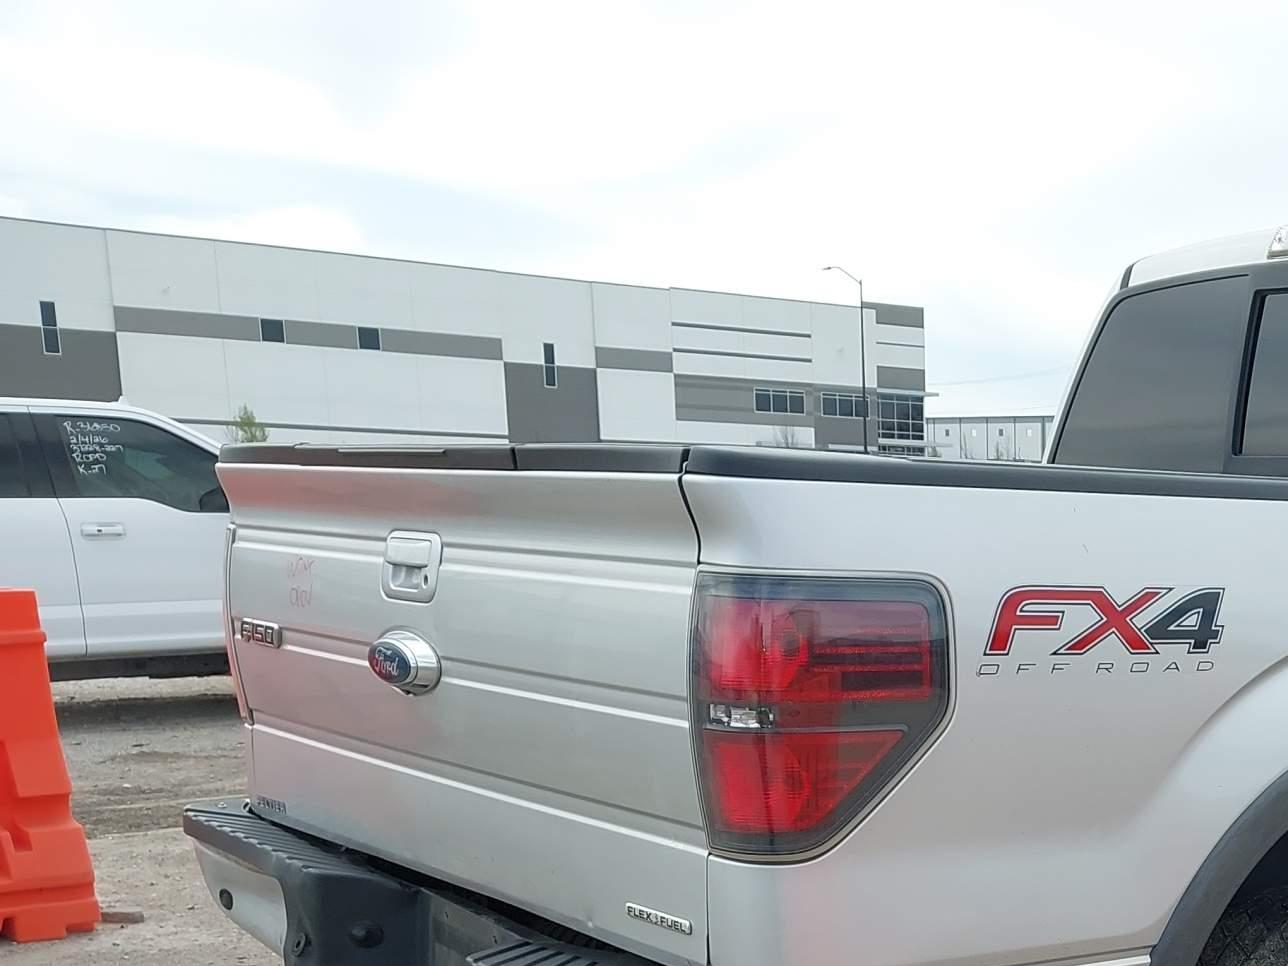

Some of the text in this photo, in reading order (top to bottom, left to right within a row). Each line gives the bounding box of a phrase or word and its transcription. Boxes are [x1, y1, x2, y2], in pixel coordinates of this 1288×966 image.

[983, 584, 1225, 656] FX4
[976, 660, 1215, 677] OFF ROAD
[626, 905, 687, 933] FLEX FUEL
